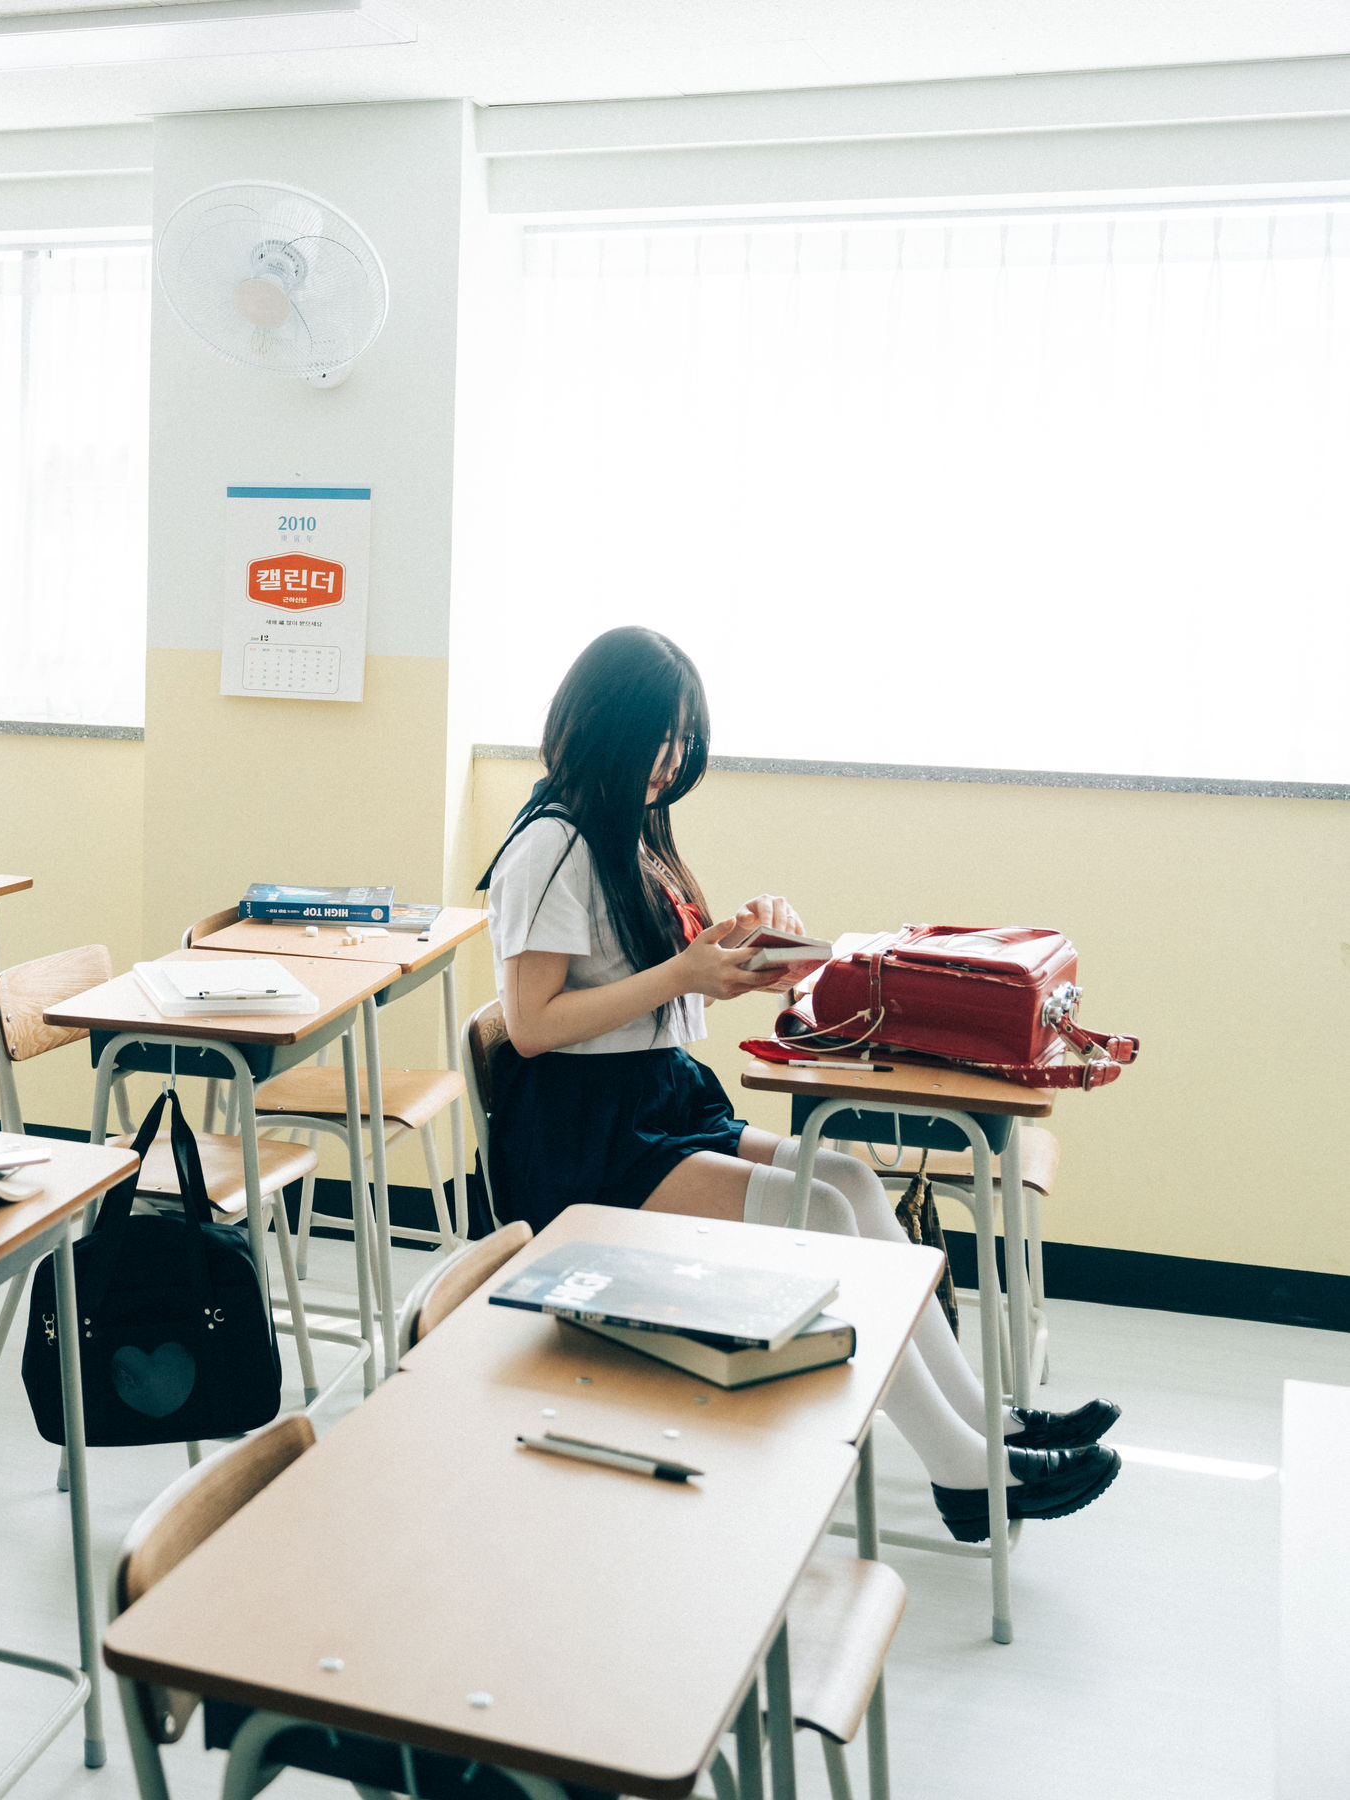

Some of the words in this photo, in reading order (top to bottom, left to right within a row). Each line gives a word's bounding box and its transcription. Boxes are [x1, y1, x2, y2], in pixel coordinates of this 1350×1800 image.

[277, 515, 317, 532] 2010
[256, 568, 335, 594] 캘린더
[302, 907, 323, 917] TOP
[324, 908, 349, 918] HIGH
